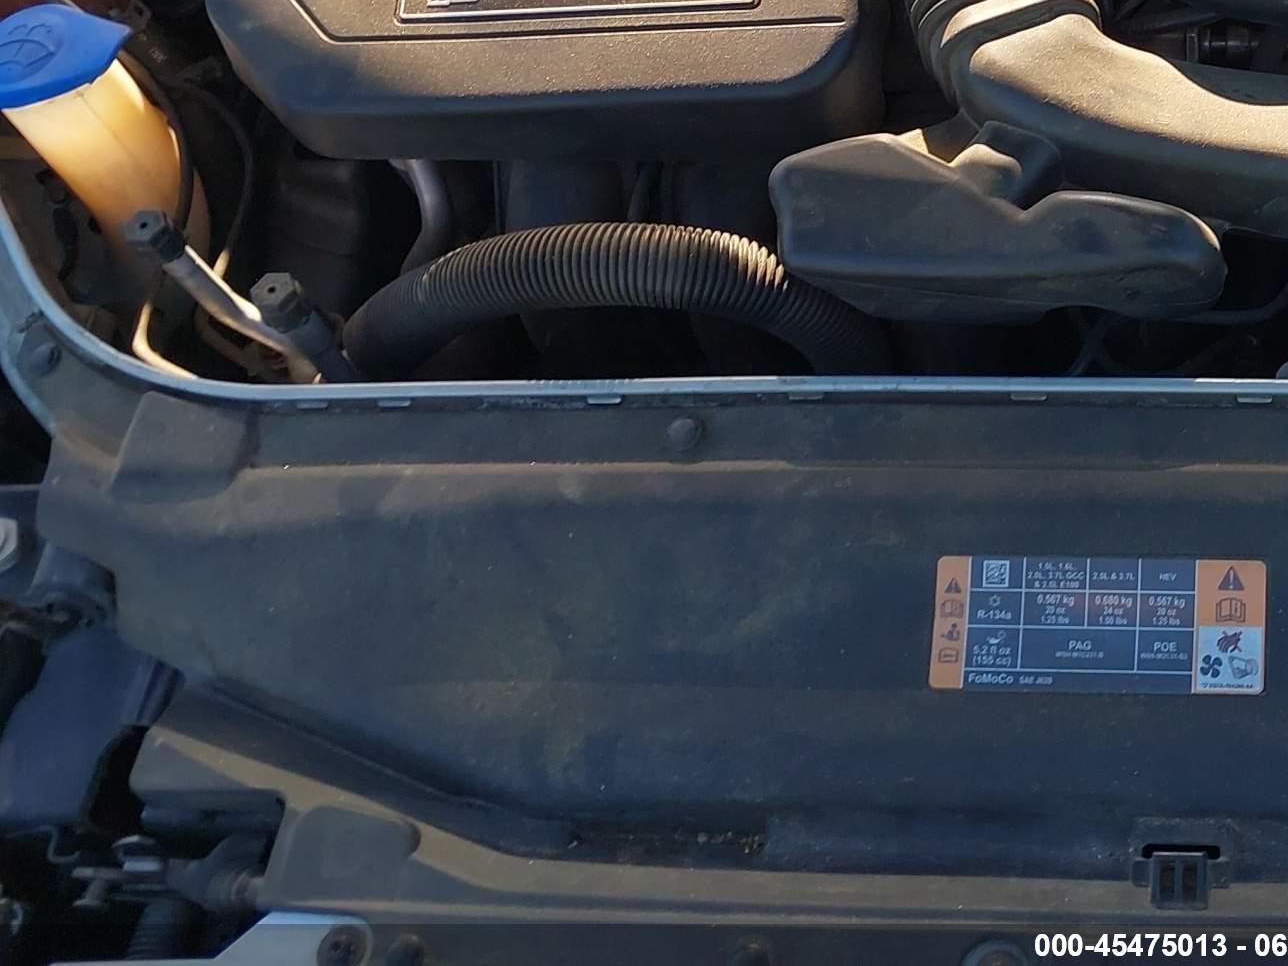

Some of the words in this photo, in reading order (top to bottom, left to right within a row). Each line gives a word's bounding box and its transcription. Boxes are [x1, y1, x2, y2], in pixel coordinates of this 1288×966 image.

[1159, 572, 1178, 582] HEV
[1036, 593, 1061, 605] 0.567
[1062, 593, 1075, 608] kg
[1120, 595, 1133, 608] kg
[1148, 596, 1173, 607] 0.567
[1173, 596, 1187, 610] kg
[976, 609, 1013, 621] R-134a
[998, 646, 1013, 656] oz
[1067, 639, 1093, 651] PAG
[1152, 640, 1178, 653] POE
[967, 673, 1015, 685] FoMoCo
